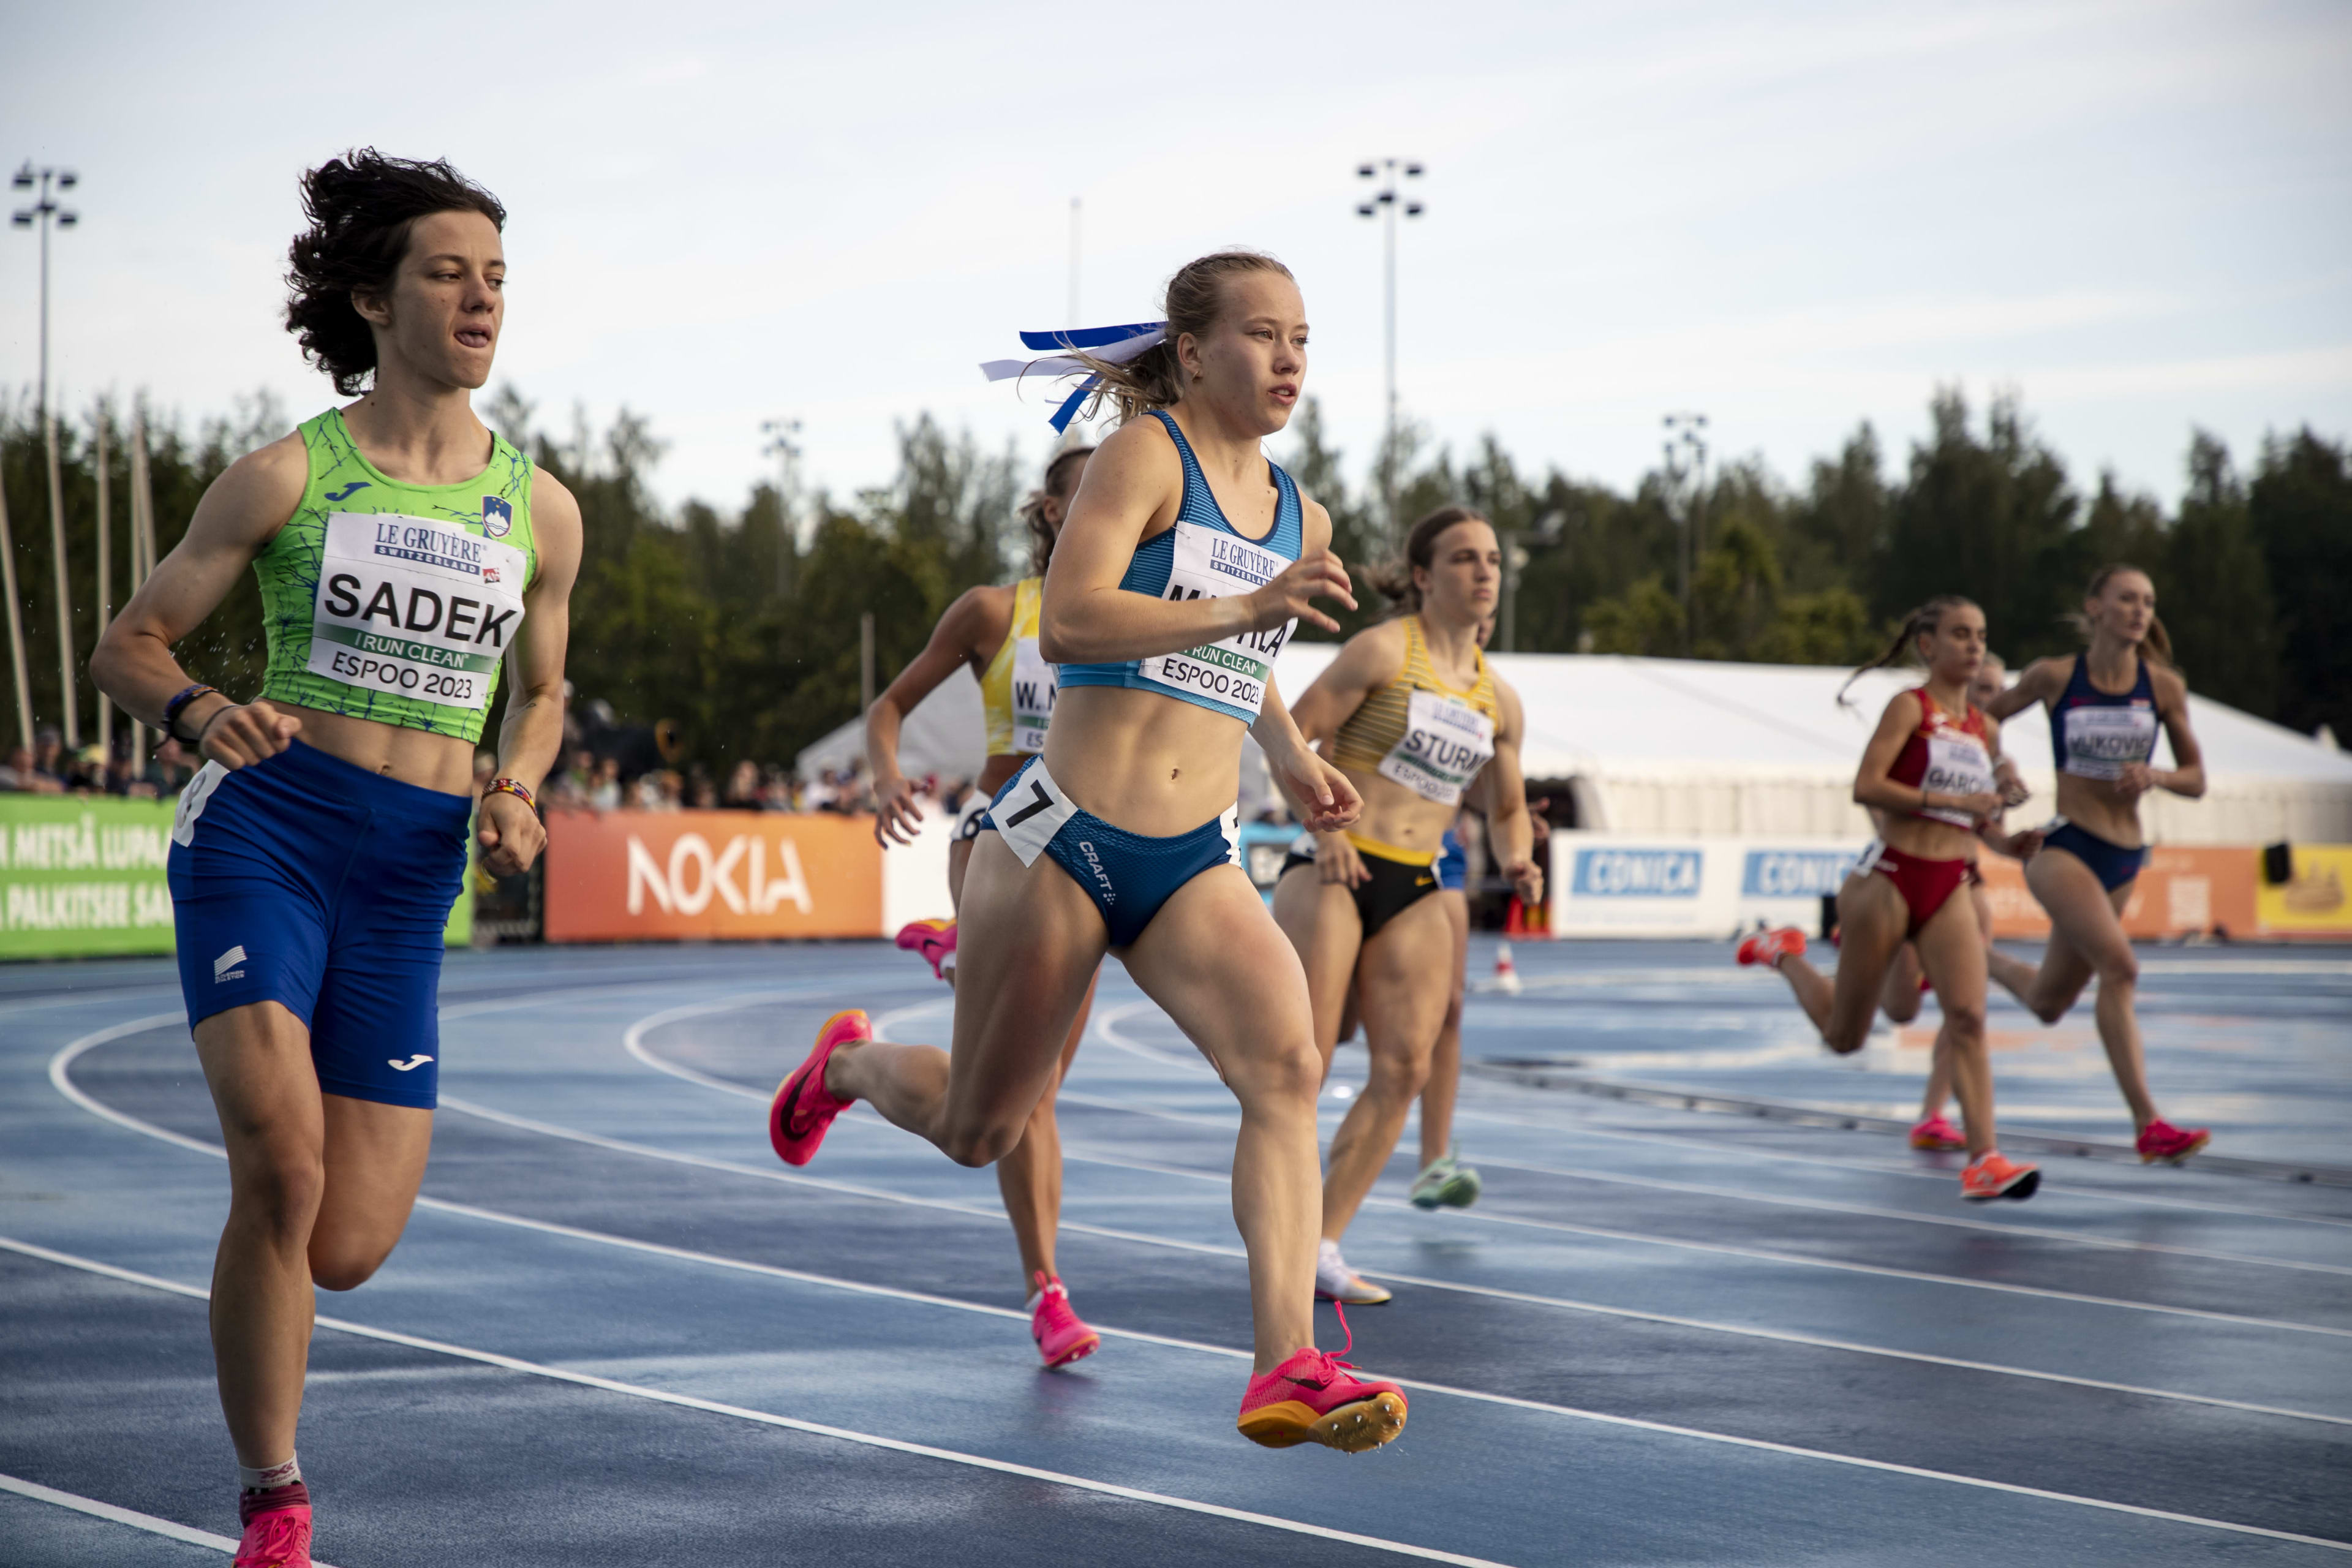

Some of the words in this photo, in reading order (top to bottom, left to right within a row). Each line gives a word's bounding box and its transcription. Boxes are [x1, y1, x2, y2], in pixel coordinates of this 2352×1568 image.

[375, 523, 399, 545] LE
[403, 527, 481, 563] GRUYÈRE
[379, 546, 477, 574] SWITZERLAND
[1212, 538, 1228, 560] LE
[1230, 544, 1276, 579] GRUYÈRE
[1213, 562, 1270, 587] SWITZERLAN
[325, 573, 518, 648] SADEK
[363, 635, 405, 656] RUN
[407, 644, 465, 668] CLEAN
[1193, 645, 1221, 663] RUN
[331, 650, 420, 689] ESPOO
[423, 673, 472, 699] 2023
[1163, 658, 1229, 693] ESPOO
[1231, 679, 1259, 705] 2023
[1005, 779, 1055, 829] 7
[626, 831, 814, 916] NOKIA
[1079, 841, 1113, 891] CRAFT
[1588, 854, 1695, 893] CONICA
